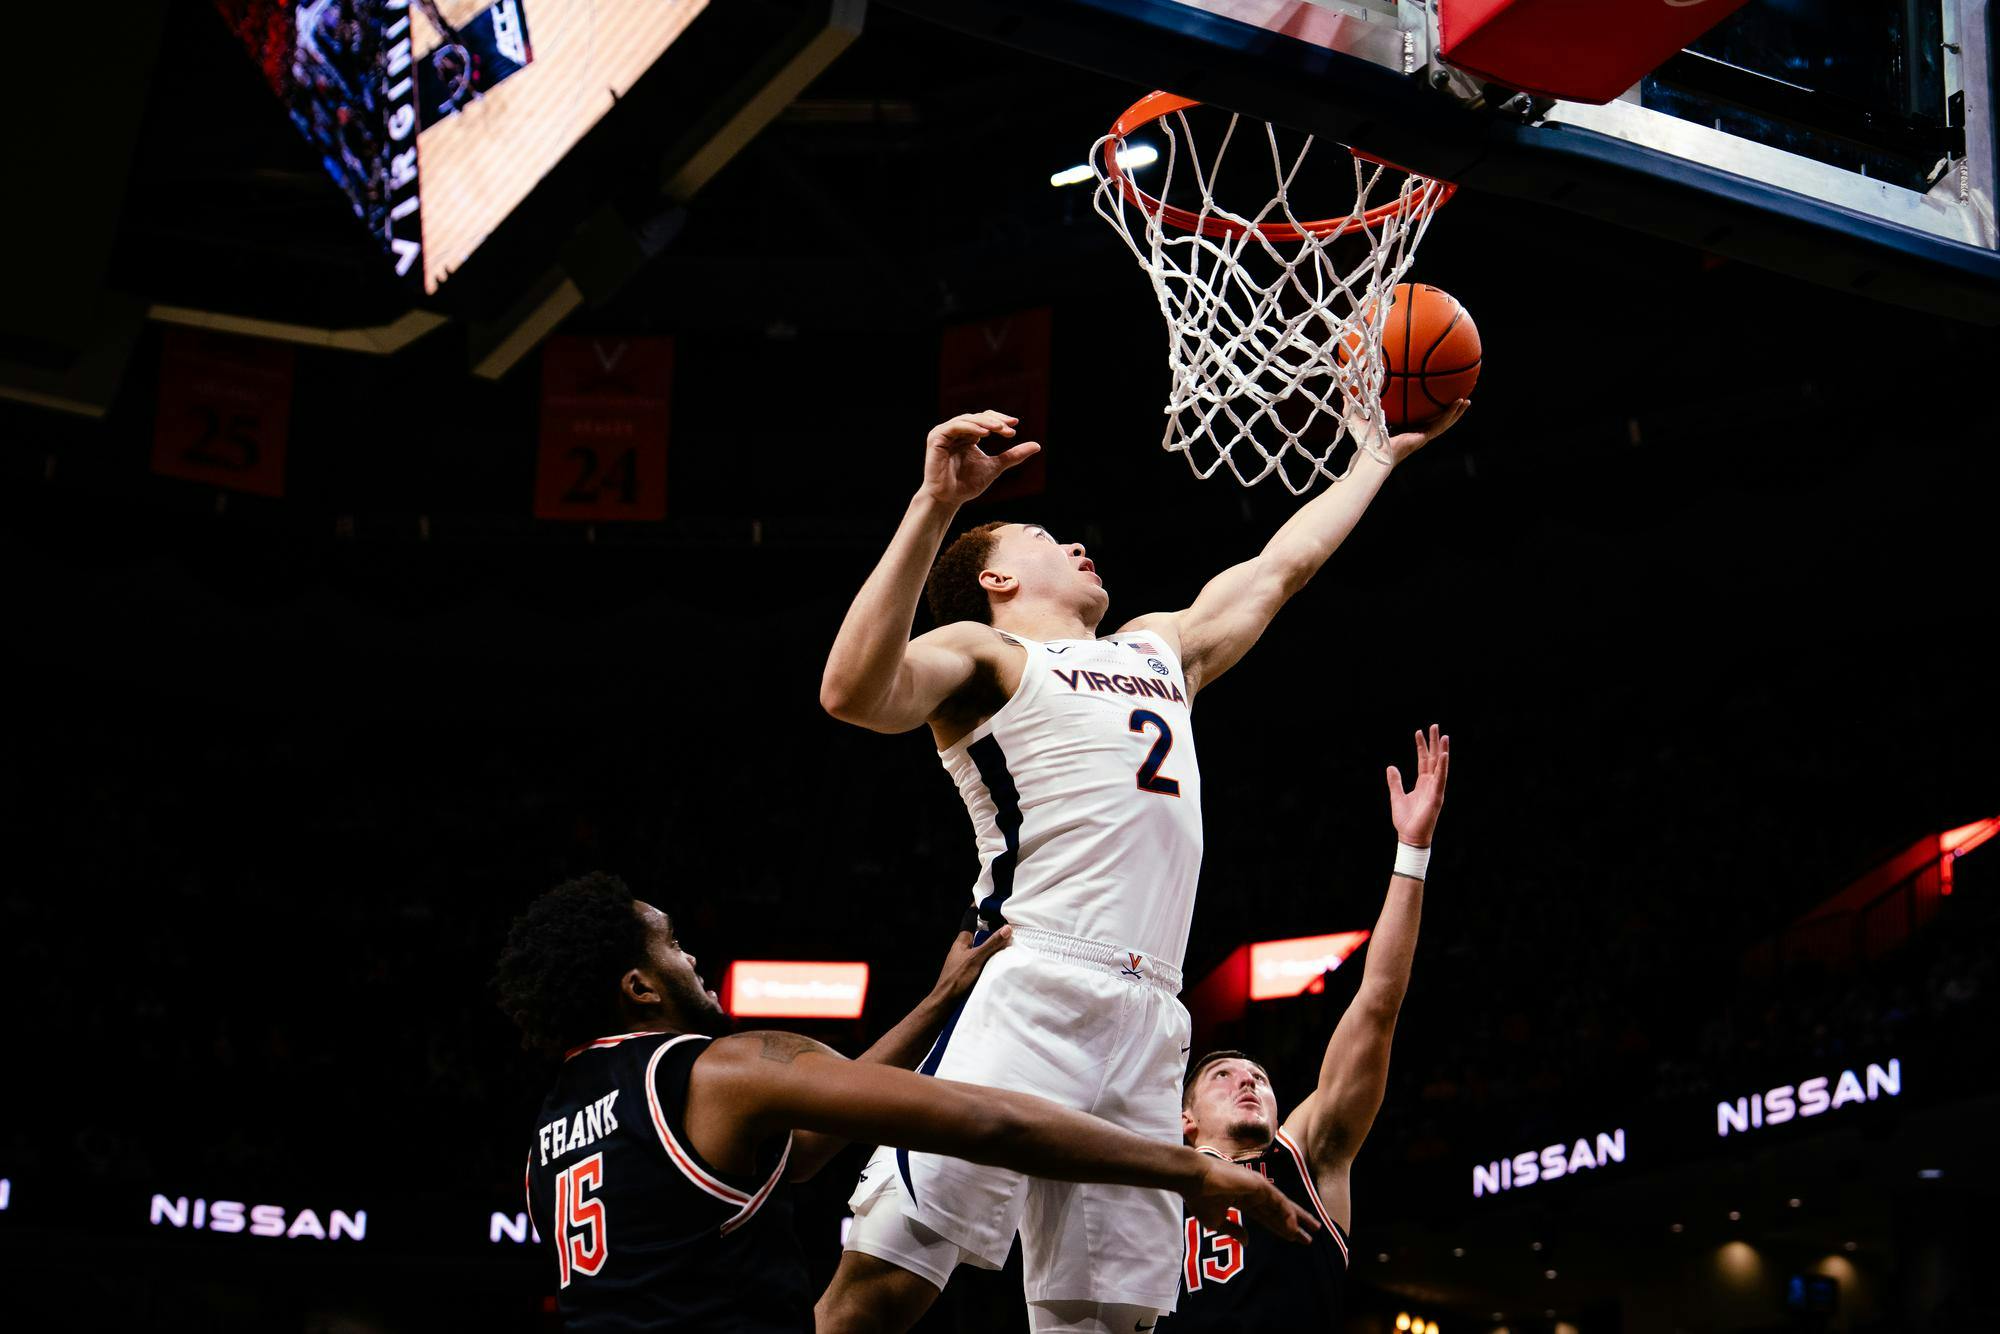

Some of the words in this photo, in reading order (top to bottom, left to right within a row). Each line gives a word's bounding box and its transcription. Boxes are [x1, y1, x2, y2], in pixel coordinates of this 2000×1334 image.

[178, 402, 260, 471] 25
[559, 446, 641, 504] 24
[1051, 669, 1188, 709] VIRGINIA
[1129, 708, 1181, 798] 2
[539, 1088, 620, 1167] FRANK
[1717, 1058, 1901, 1136] NISSAN
[1473, 1128, 1626, 1197] NISSAN
[150, 1194, 367, 1241] NISSAN
[555, 1151, 608, 1290] 15
[1183, 1206, 1245, 1293] 13
